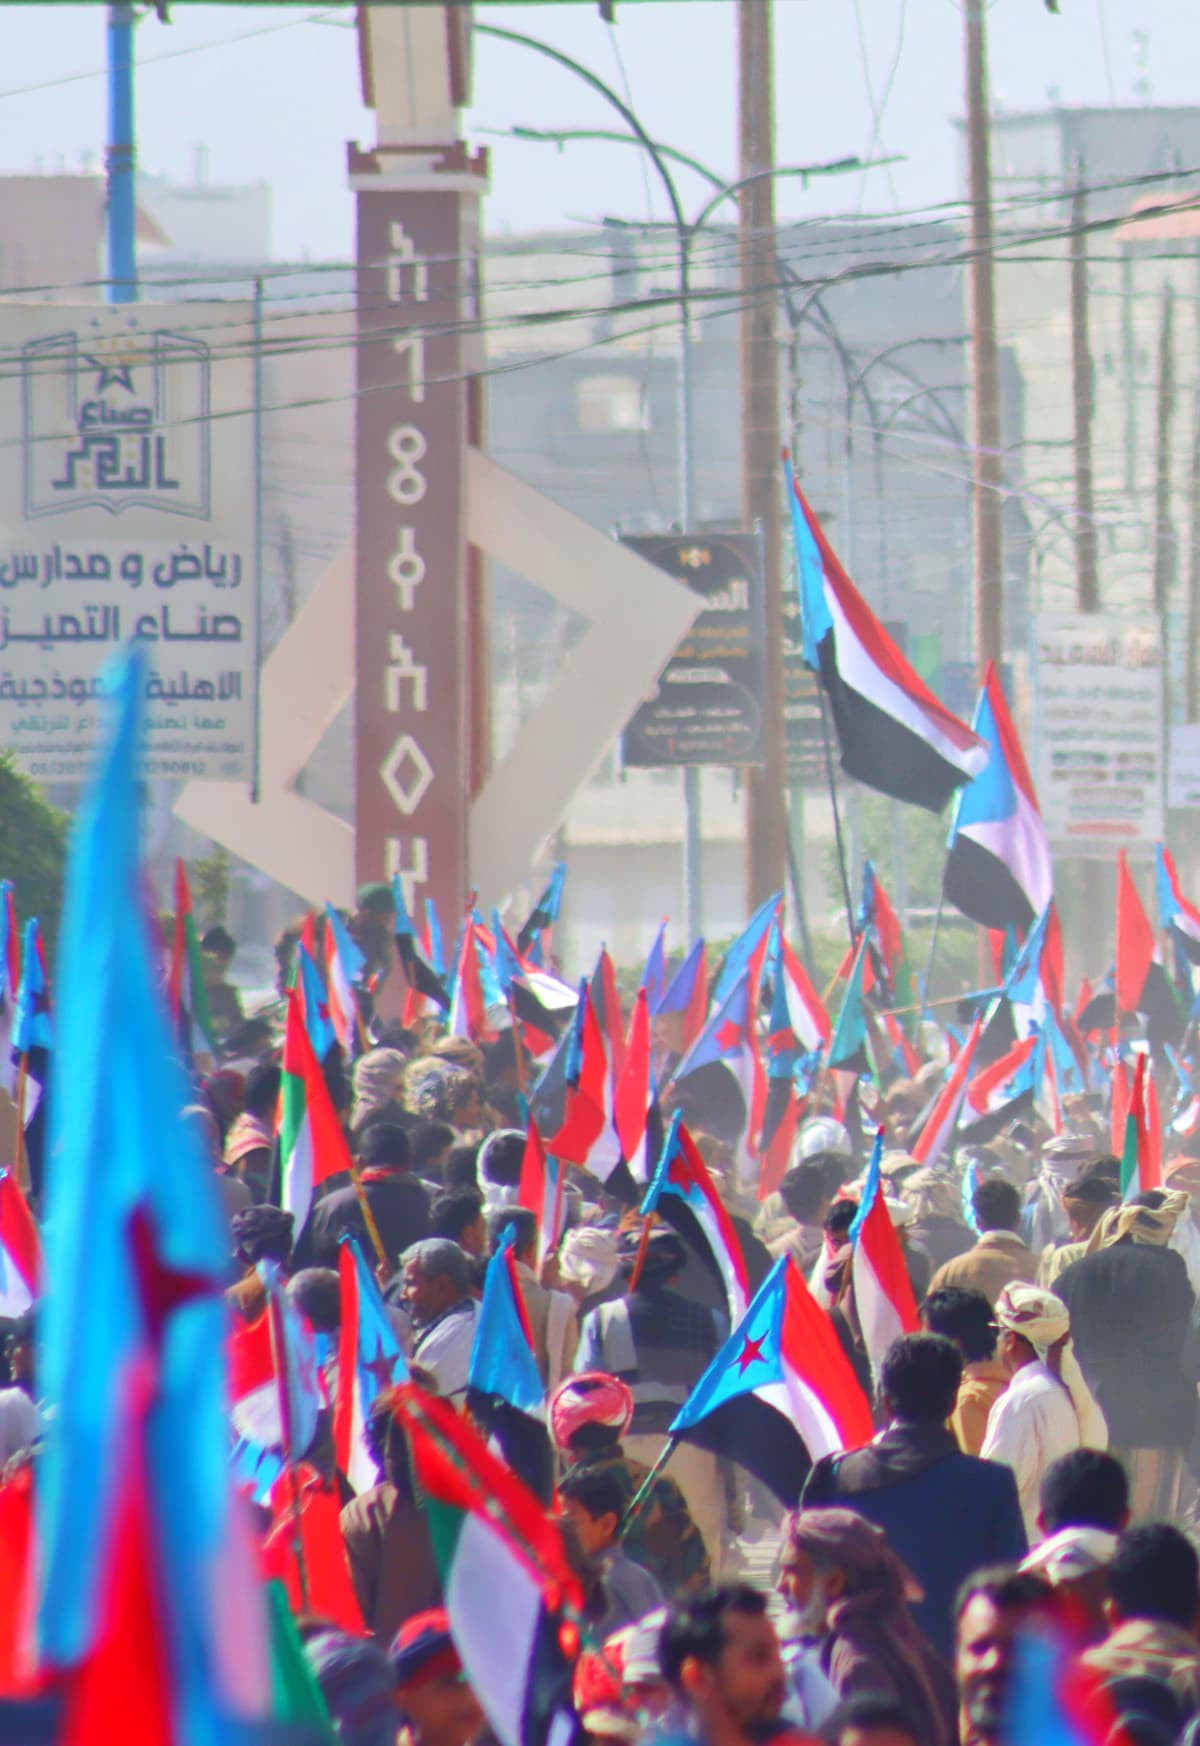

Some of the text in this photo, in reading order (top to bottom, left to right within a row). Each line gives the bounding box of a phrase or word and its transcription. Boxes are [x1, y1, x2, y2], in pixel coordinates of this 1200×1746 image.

[0, 544, 242, 589] رياض و مدارس
